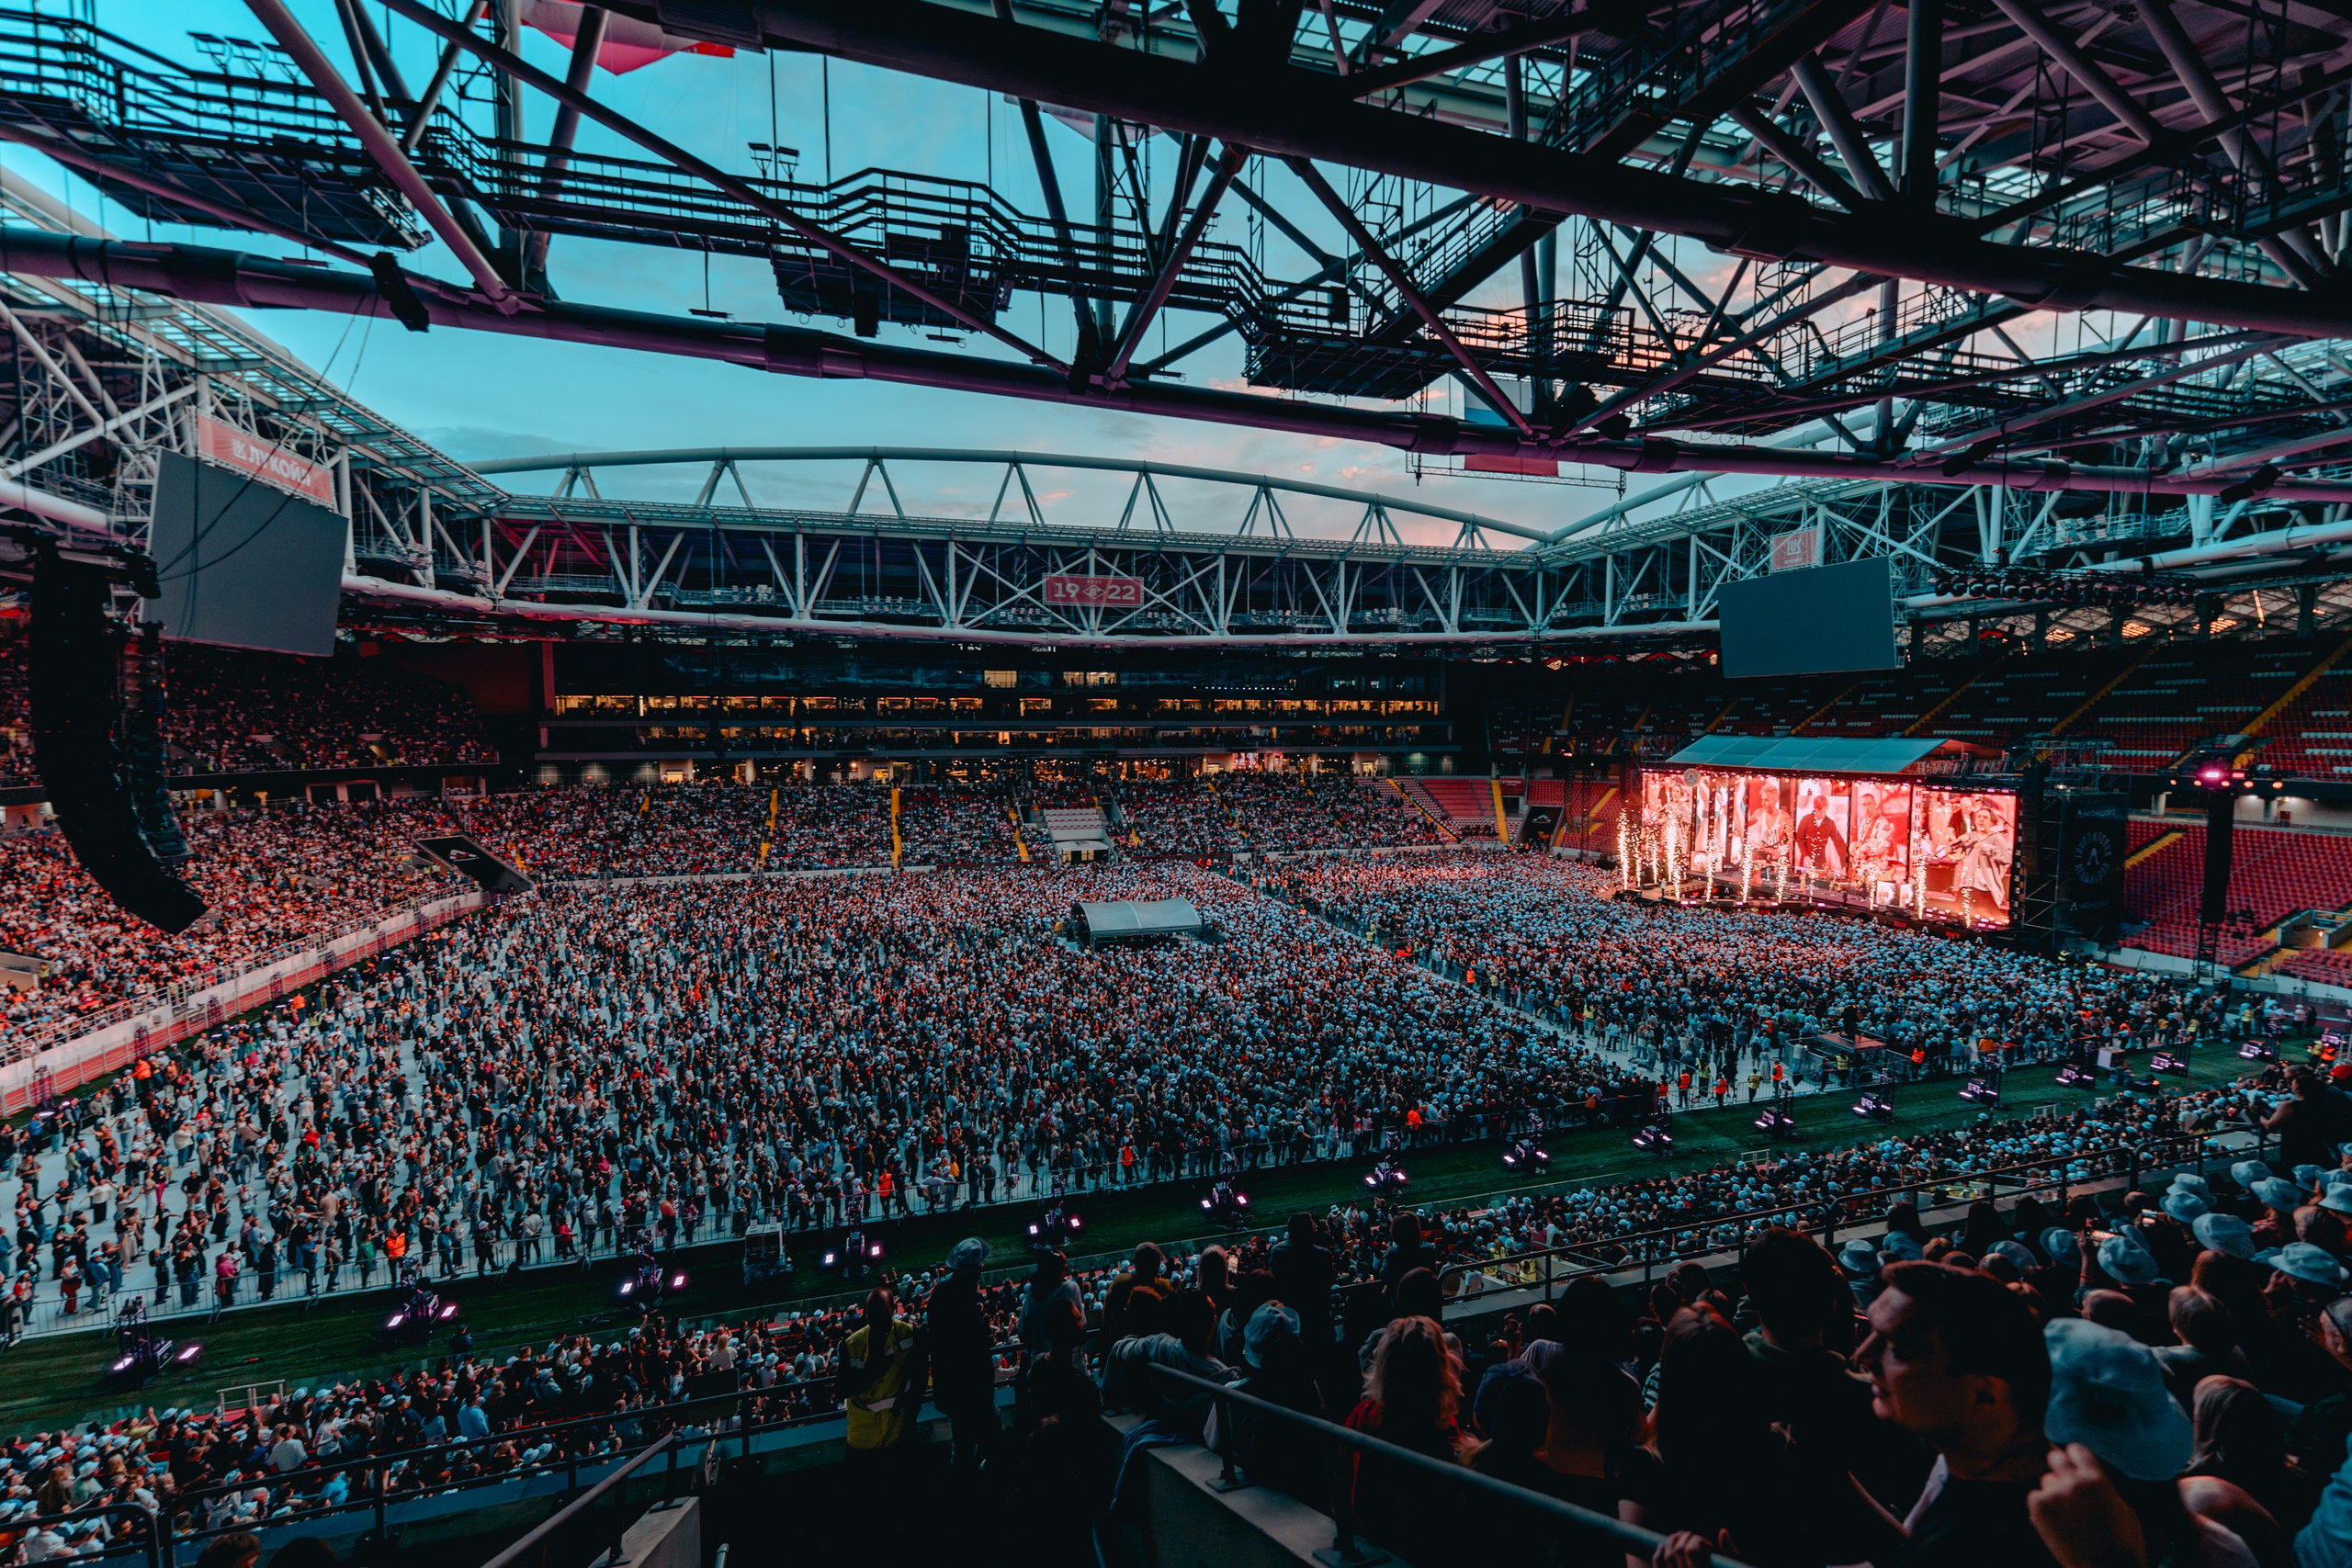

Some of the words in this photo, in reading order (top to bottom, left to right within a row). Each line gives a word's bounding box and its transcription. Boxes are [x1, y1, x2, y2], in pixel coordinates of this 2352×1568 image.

[248, 445, 311, 487] ЛУКОЙЛ
[1787, 537, 1802, 556] LUK
[1054, 582, 1080, 598] 19
[1107, 584, 1136, 600] 22
